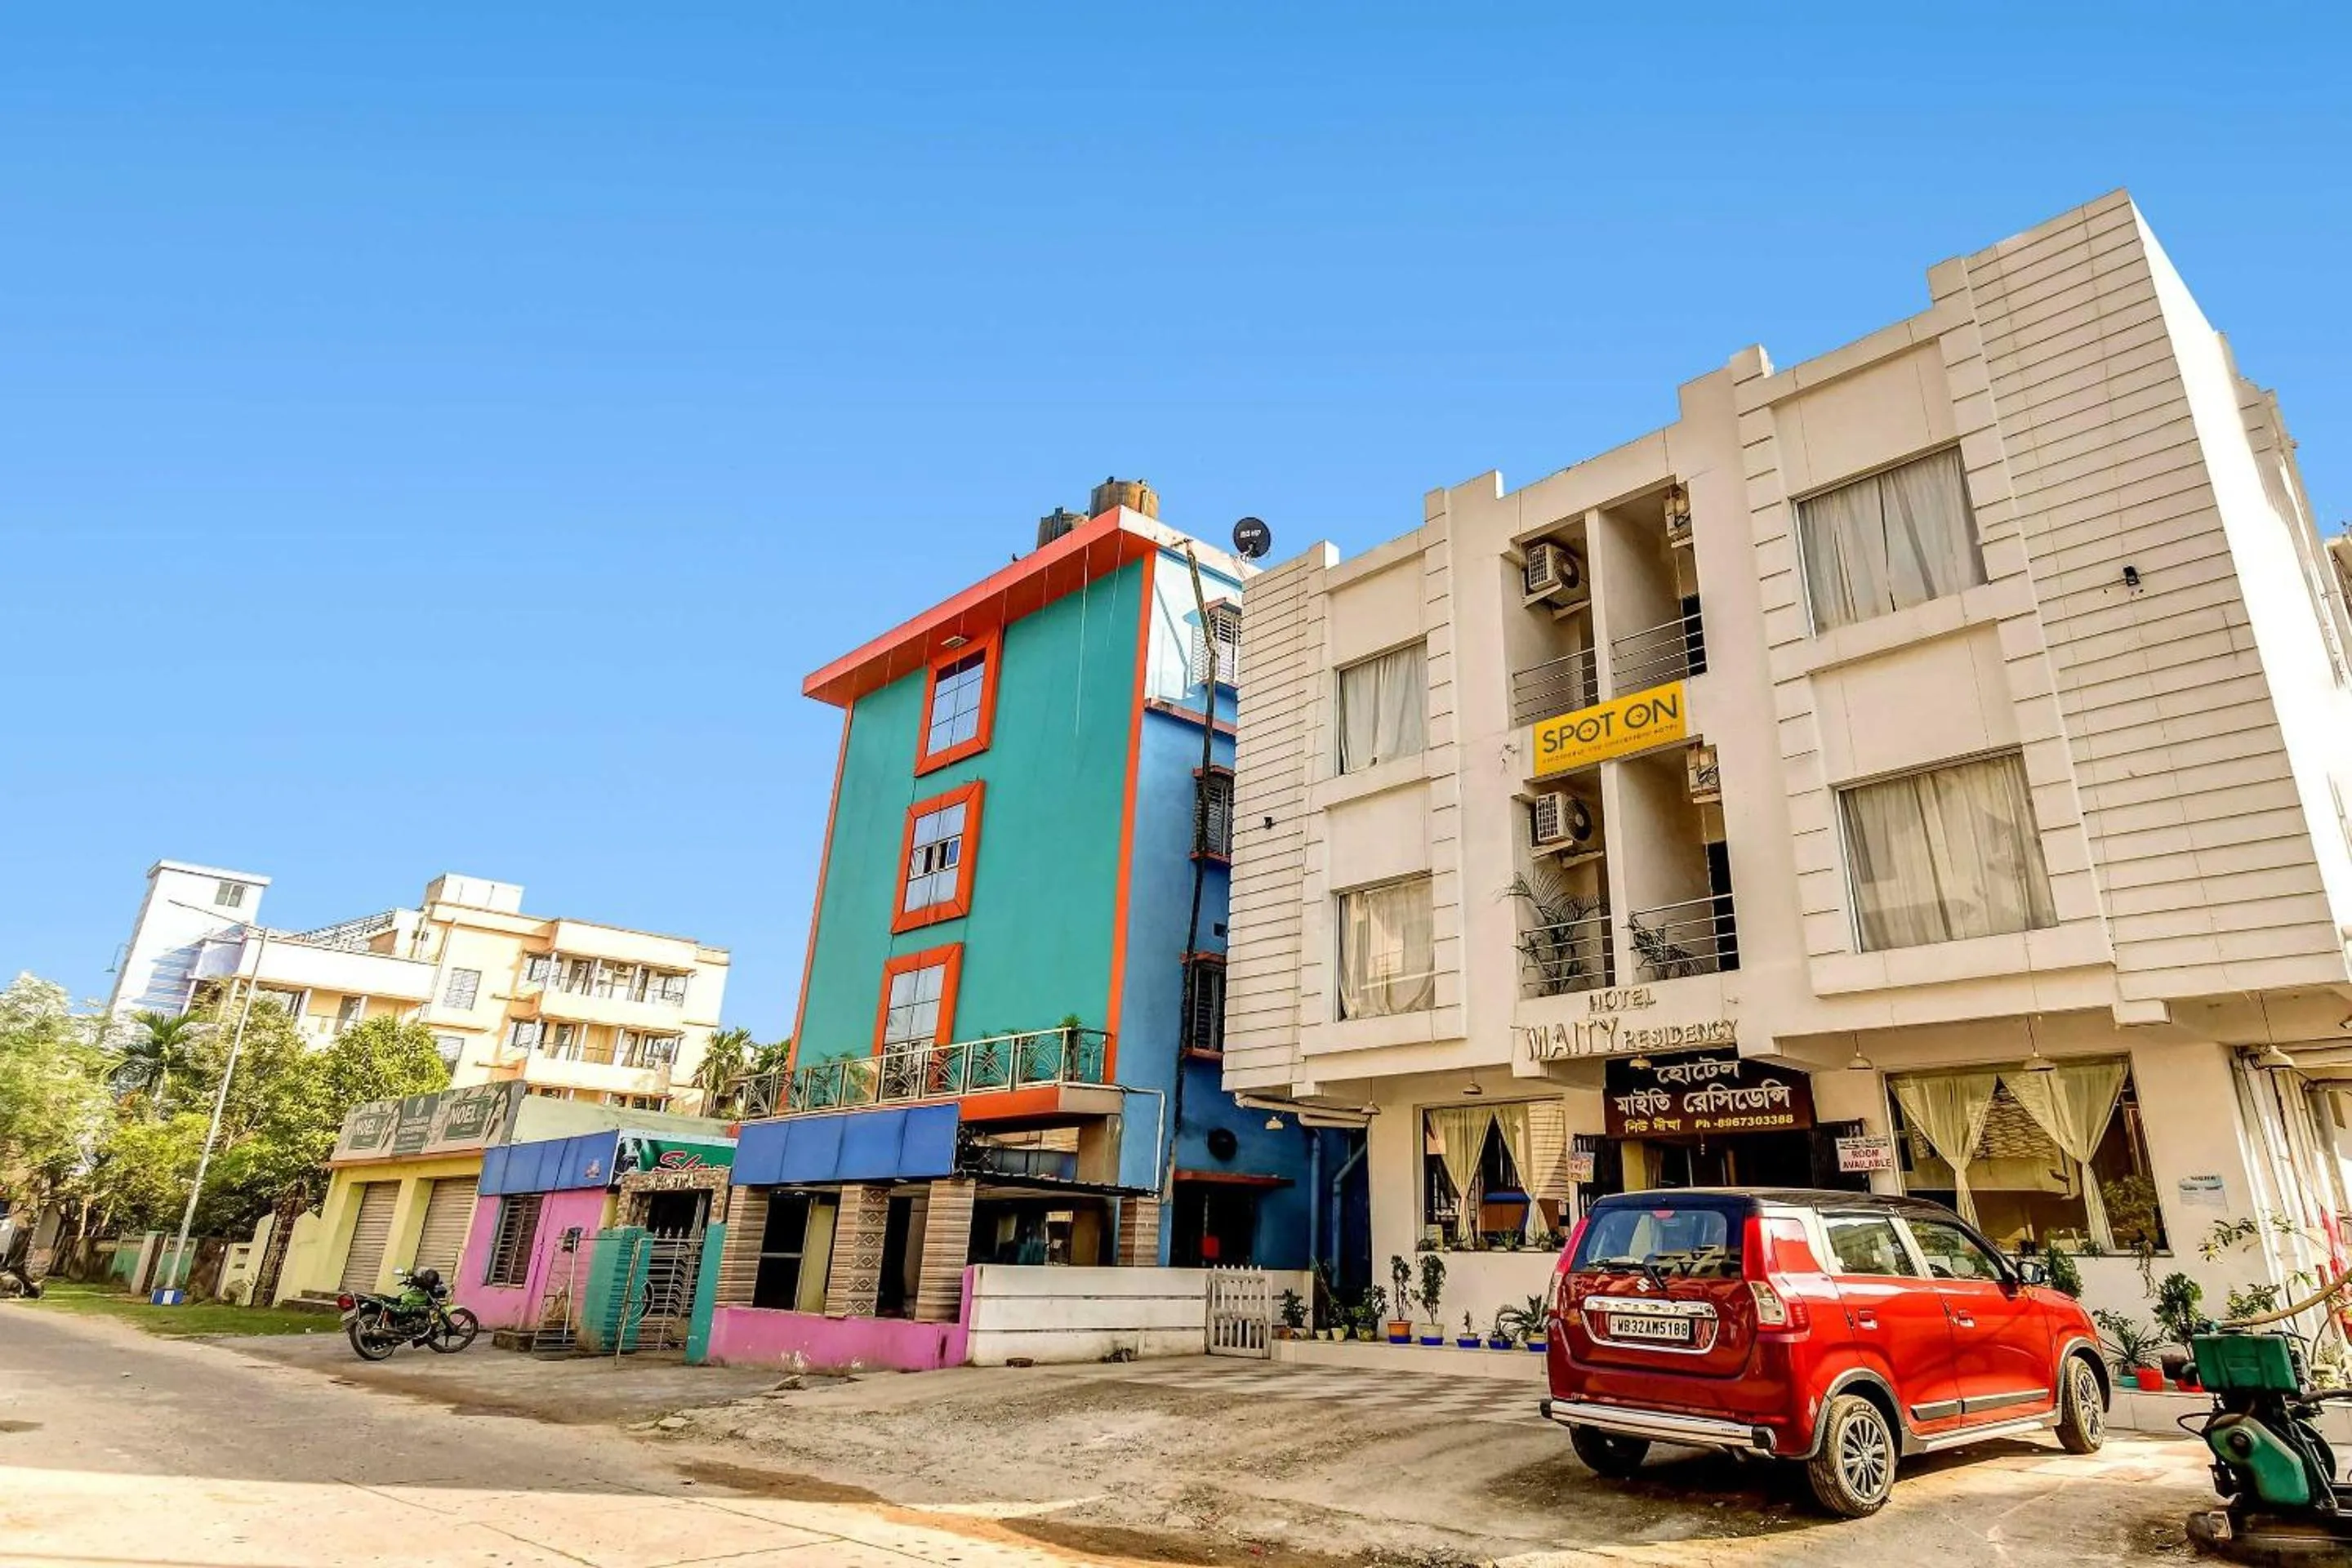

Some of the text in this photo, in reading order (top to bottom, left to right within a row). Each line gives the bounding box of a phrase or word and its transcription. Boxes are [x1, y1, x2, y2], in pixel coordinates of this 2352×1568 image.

[1542, 710, 1616, 754] SPOT
[1624, 693, 1678, 729] ON
[1588, 987, 1657, 1013] HOTEL
[1526, 1016, 1739, 1061] MAITY RESIDENCY
[1651, 1055, 1741, 1085] হোটেল
[1613, 1077, 1793, 1117] মাইতি রেসিডেন্সি
[1842, 1158, 1892, 1169] AVAILABLE
[1851, 1148, 1879, 1159] ROOM
